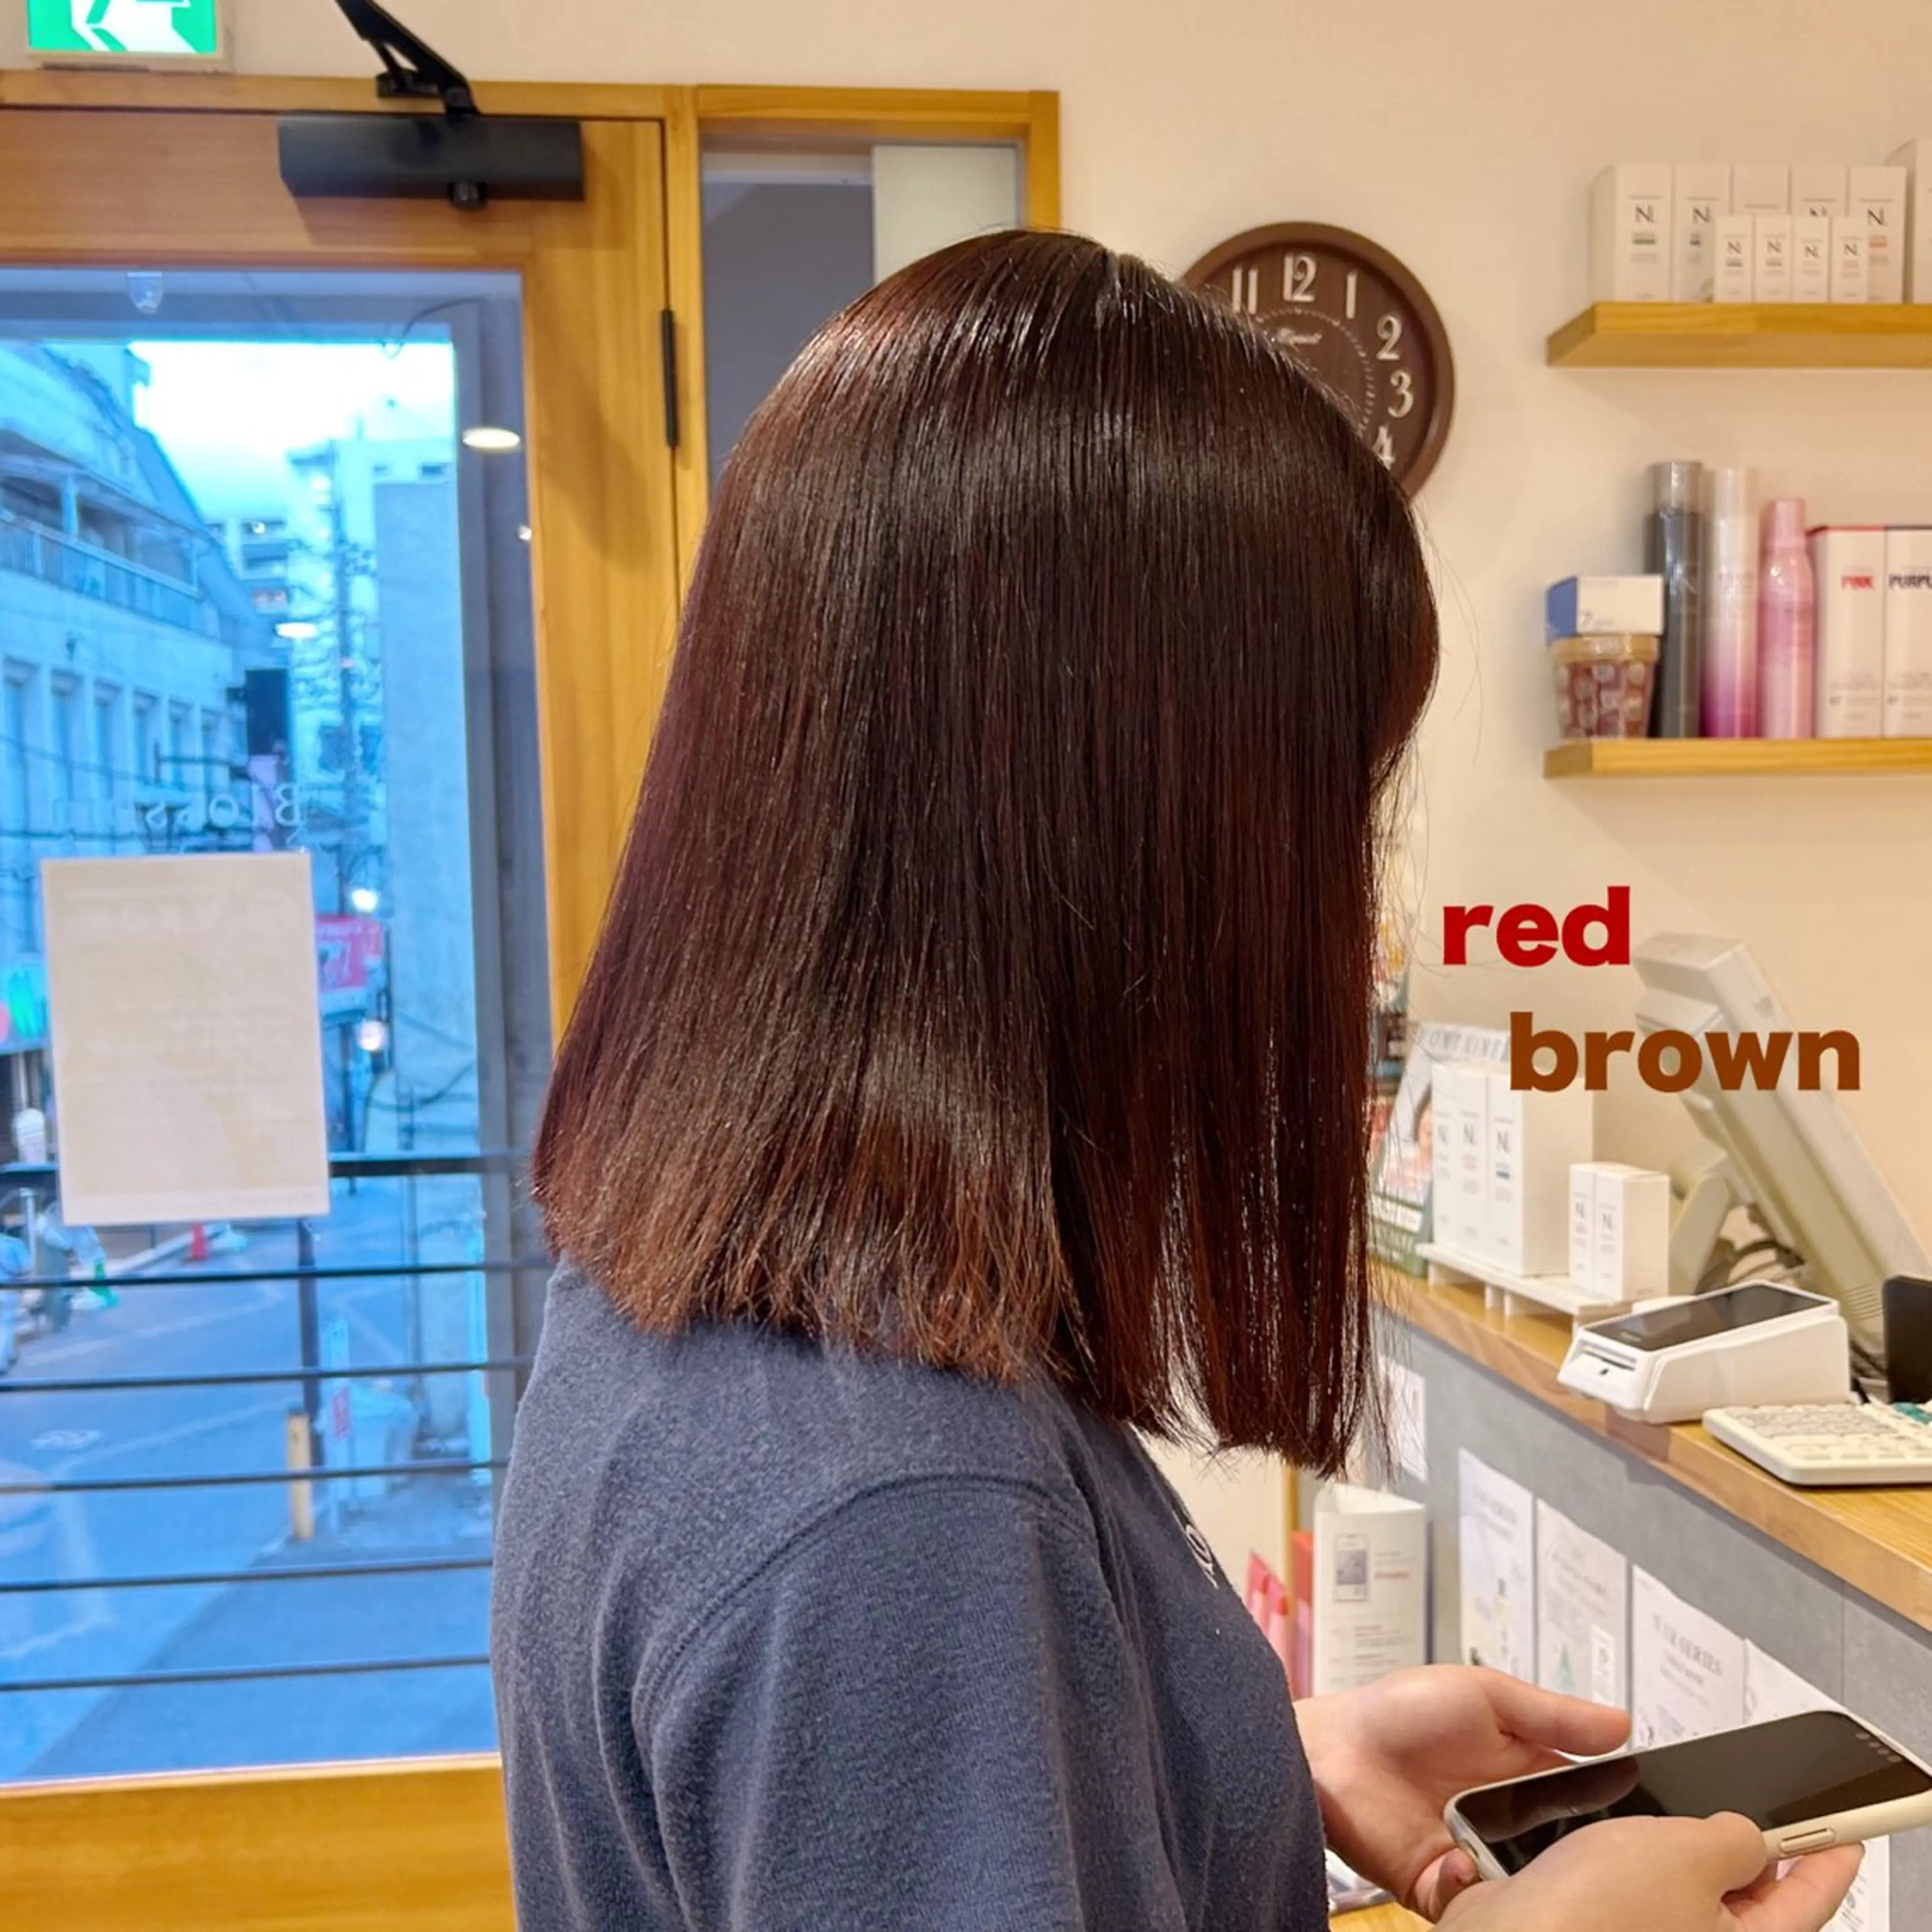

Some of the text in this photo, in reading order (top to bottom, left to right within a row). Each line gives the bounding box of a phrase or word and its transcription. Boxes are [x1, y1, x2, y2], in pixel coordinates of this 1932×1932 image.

[1232, 263, 1259, 315] 11
[1283, 253, 1317, 302] 12
[1346, 270, 1358, 319] 1
[1377, 314, 1403, 361] 2
[1388, 370, 1414, 418] 3
[1373, 426, 1395, 470] 4
